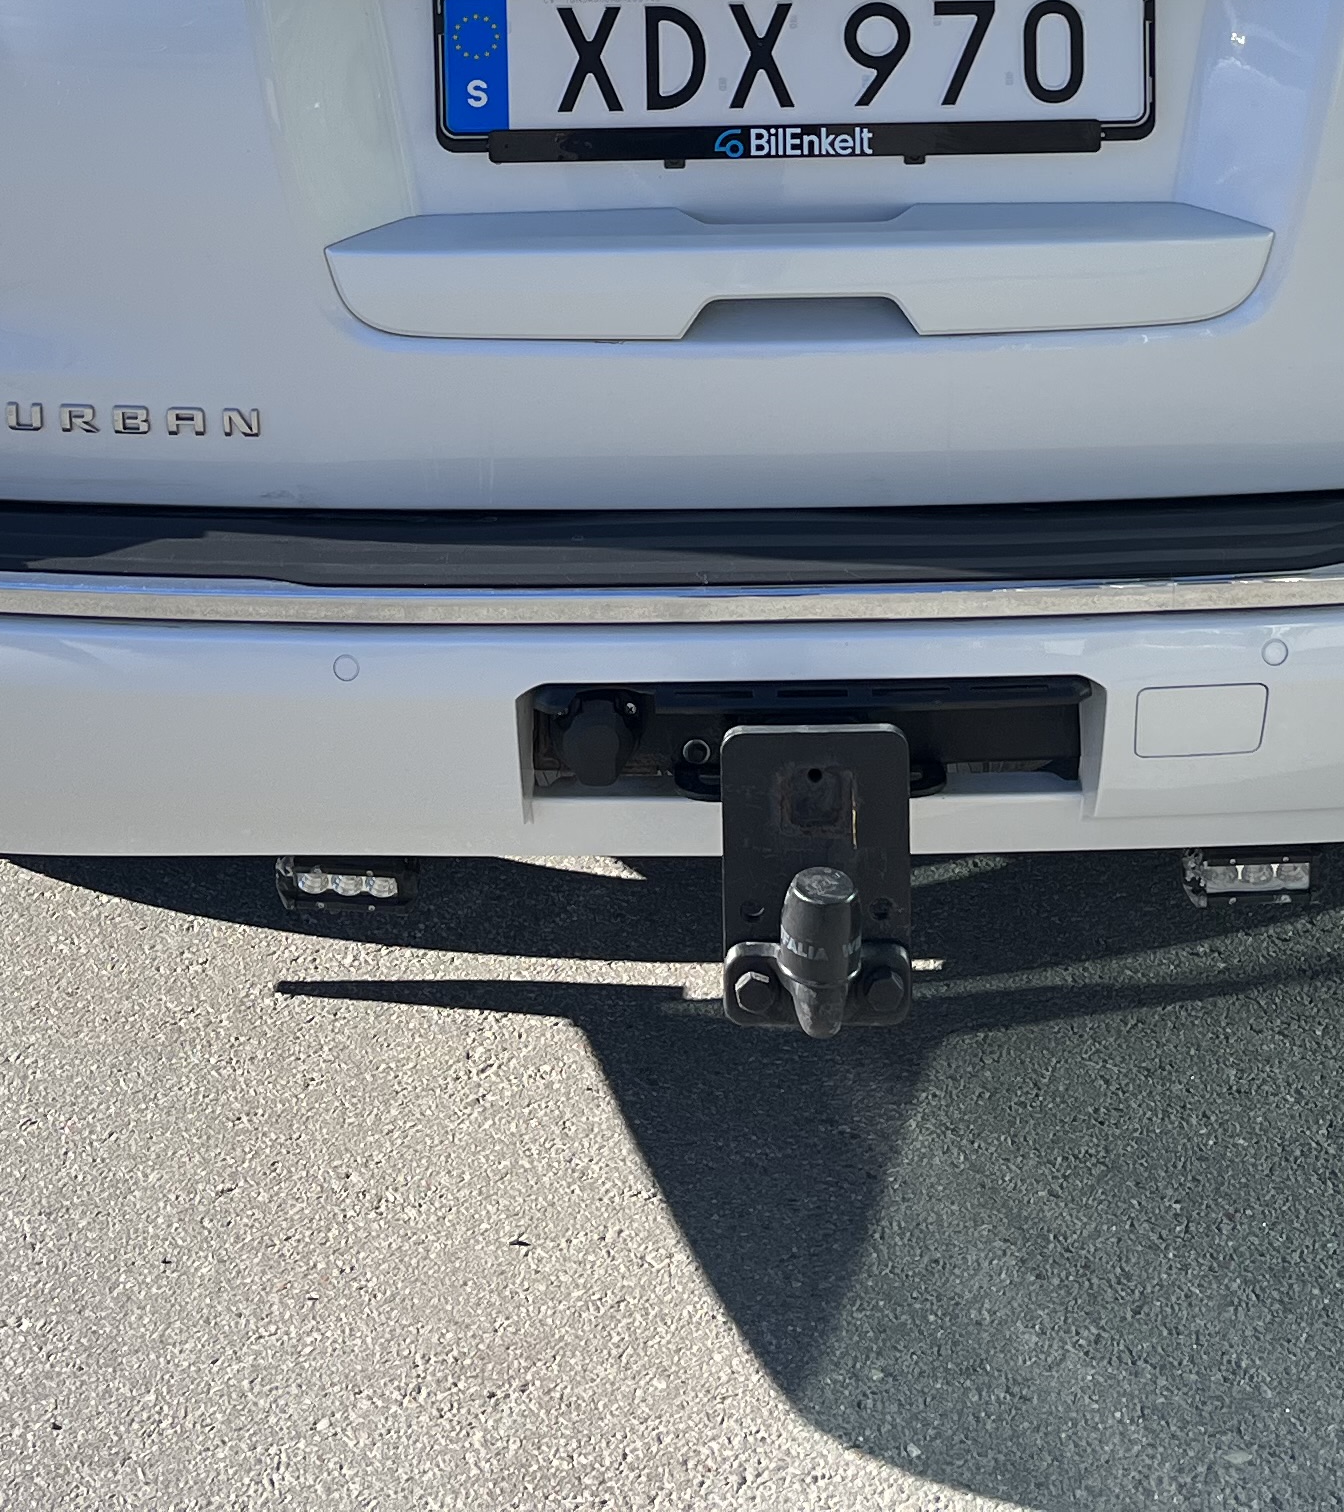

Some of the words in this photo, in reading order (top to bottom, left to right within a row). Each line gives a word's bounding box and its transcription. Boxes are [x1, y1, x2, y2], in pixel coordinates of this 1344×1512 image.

[556, 2, 795, 113] XDX
[843, 0, 1085, 107] 970
[467, 79, 488, 108] S
[750, 126, 874, 156] BilEnkelt
